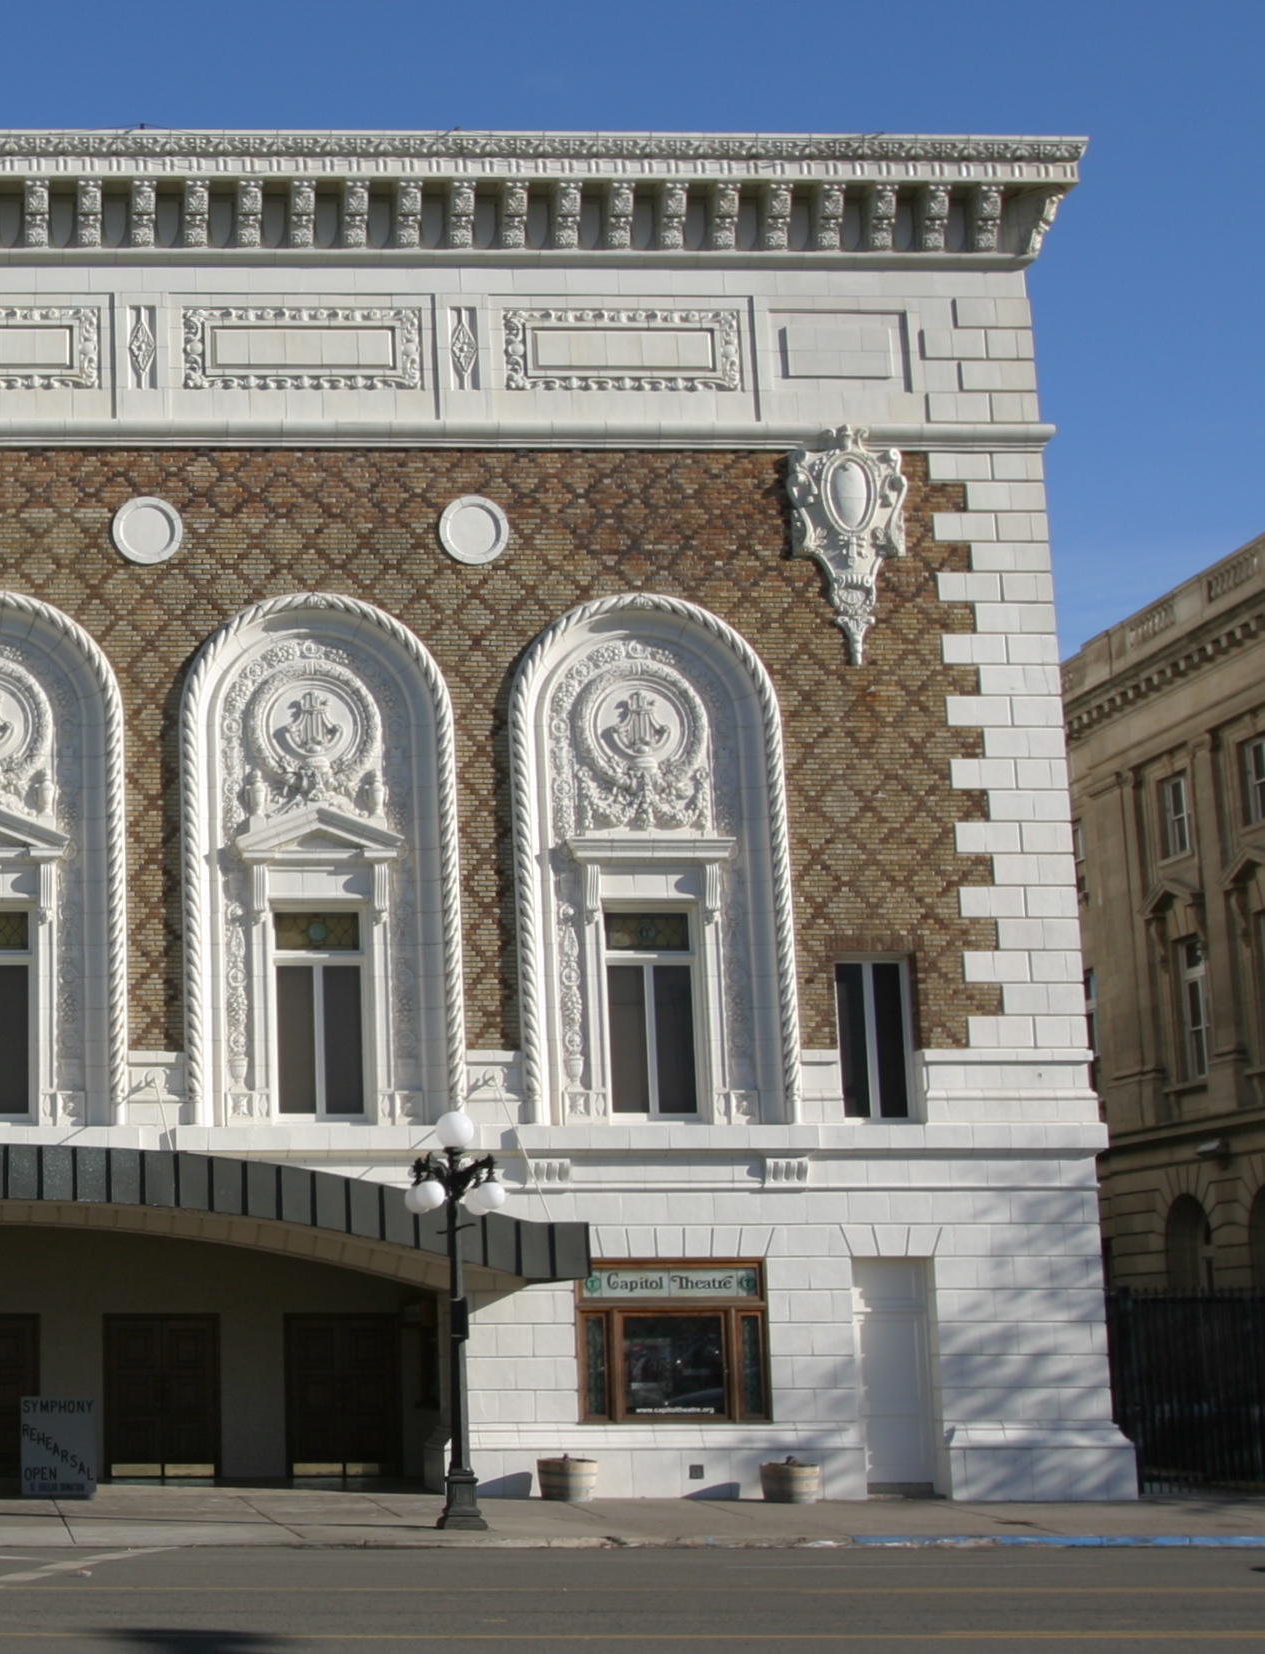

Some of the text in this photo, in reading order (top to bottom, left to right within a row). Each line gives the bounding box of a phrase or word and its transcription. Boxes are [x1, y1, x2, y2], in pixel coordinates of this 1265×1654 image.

[606, 1272, 734, 1292] Capitol Theatre
[22, 1400, 94, 1413] SYMPHONY
[635, 1406, 715, 1415] www.capitoltheatre.org
[22, 1424, 94, 1481] REHEARSAL
[24, 1467, 57, 1481] OPEN
